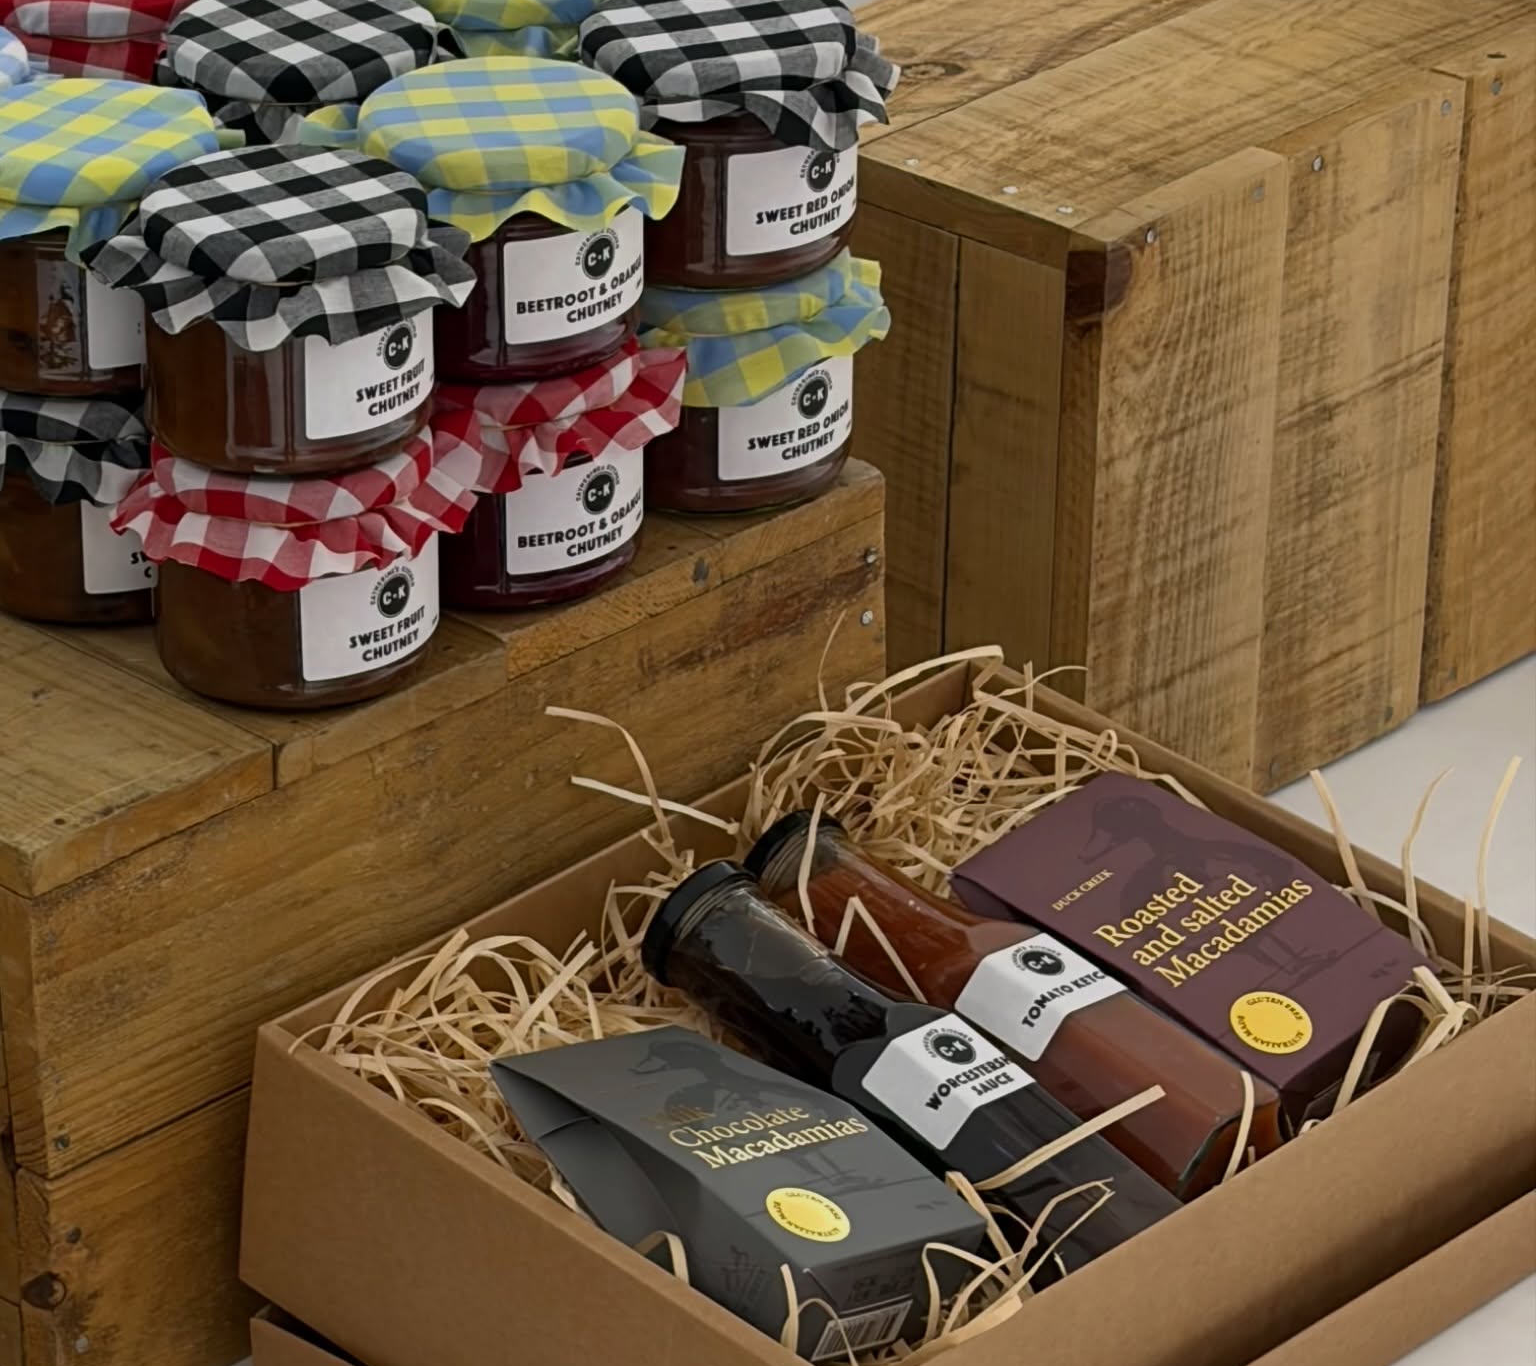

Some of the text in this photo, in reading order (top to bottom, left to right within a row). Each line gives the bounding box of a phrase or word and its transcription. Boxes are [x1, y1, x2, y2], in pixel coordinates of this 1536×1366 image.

[755, 203, 804, 225] SWEET
[806, 194, 828, 215] RED
[789, 205, 842, 236] CHUTNEY
[516, 286, 596, 315] BEETROOT
[599, 282, 608, 297] &
[566, 290, 624, 323] CHUTNEY
[356, 358, 426, 404] SWEET FRUIT
[368, 381, 421, 417] CHUTNEY
[747, 430, 795, 451] SWEET
[797, 421, 821, 440] RED
[781, 428, 835, 461] CHUTNEY
[517, 520, 596, 549] BEETROOT
[598, 517, 608, 530] &
[566, 524, 624, 557] CHUTNEY
[349, 605, 426, 649] SWEET FRUIT
[361, 627, 420, 662] CHUTNEY
[1051, 868, 1115, 912] DUCK CREEK
[1093, 871, 1205, 948] Roasted
[1132, 873, 1258, 967] and salted
[1153, 877, 1314, 989] Macadamias
[1020, 968, 1109, 1030] TOMATO KETC
[1245, 995, 1285, 1007] GLUTEN
[924, 1055, 1014, 1113] WORCESTERSH
[970, 1072, 1015, 1097] SAUCE
[668, 1105, 811, 1148] Chocolate
[691, 1115, 870, 1170] Macadamias
